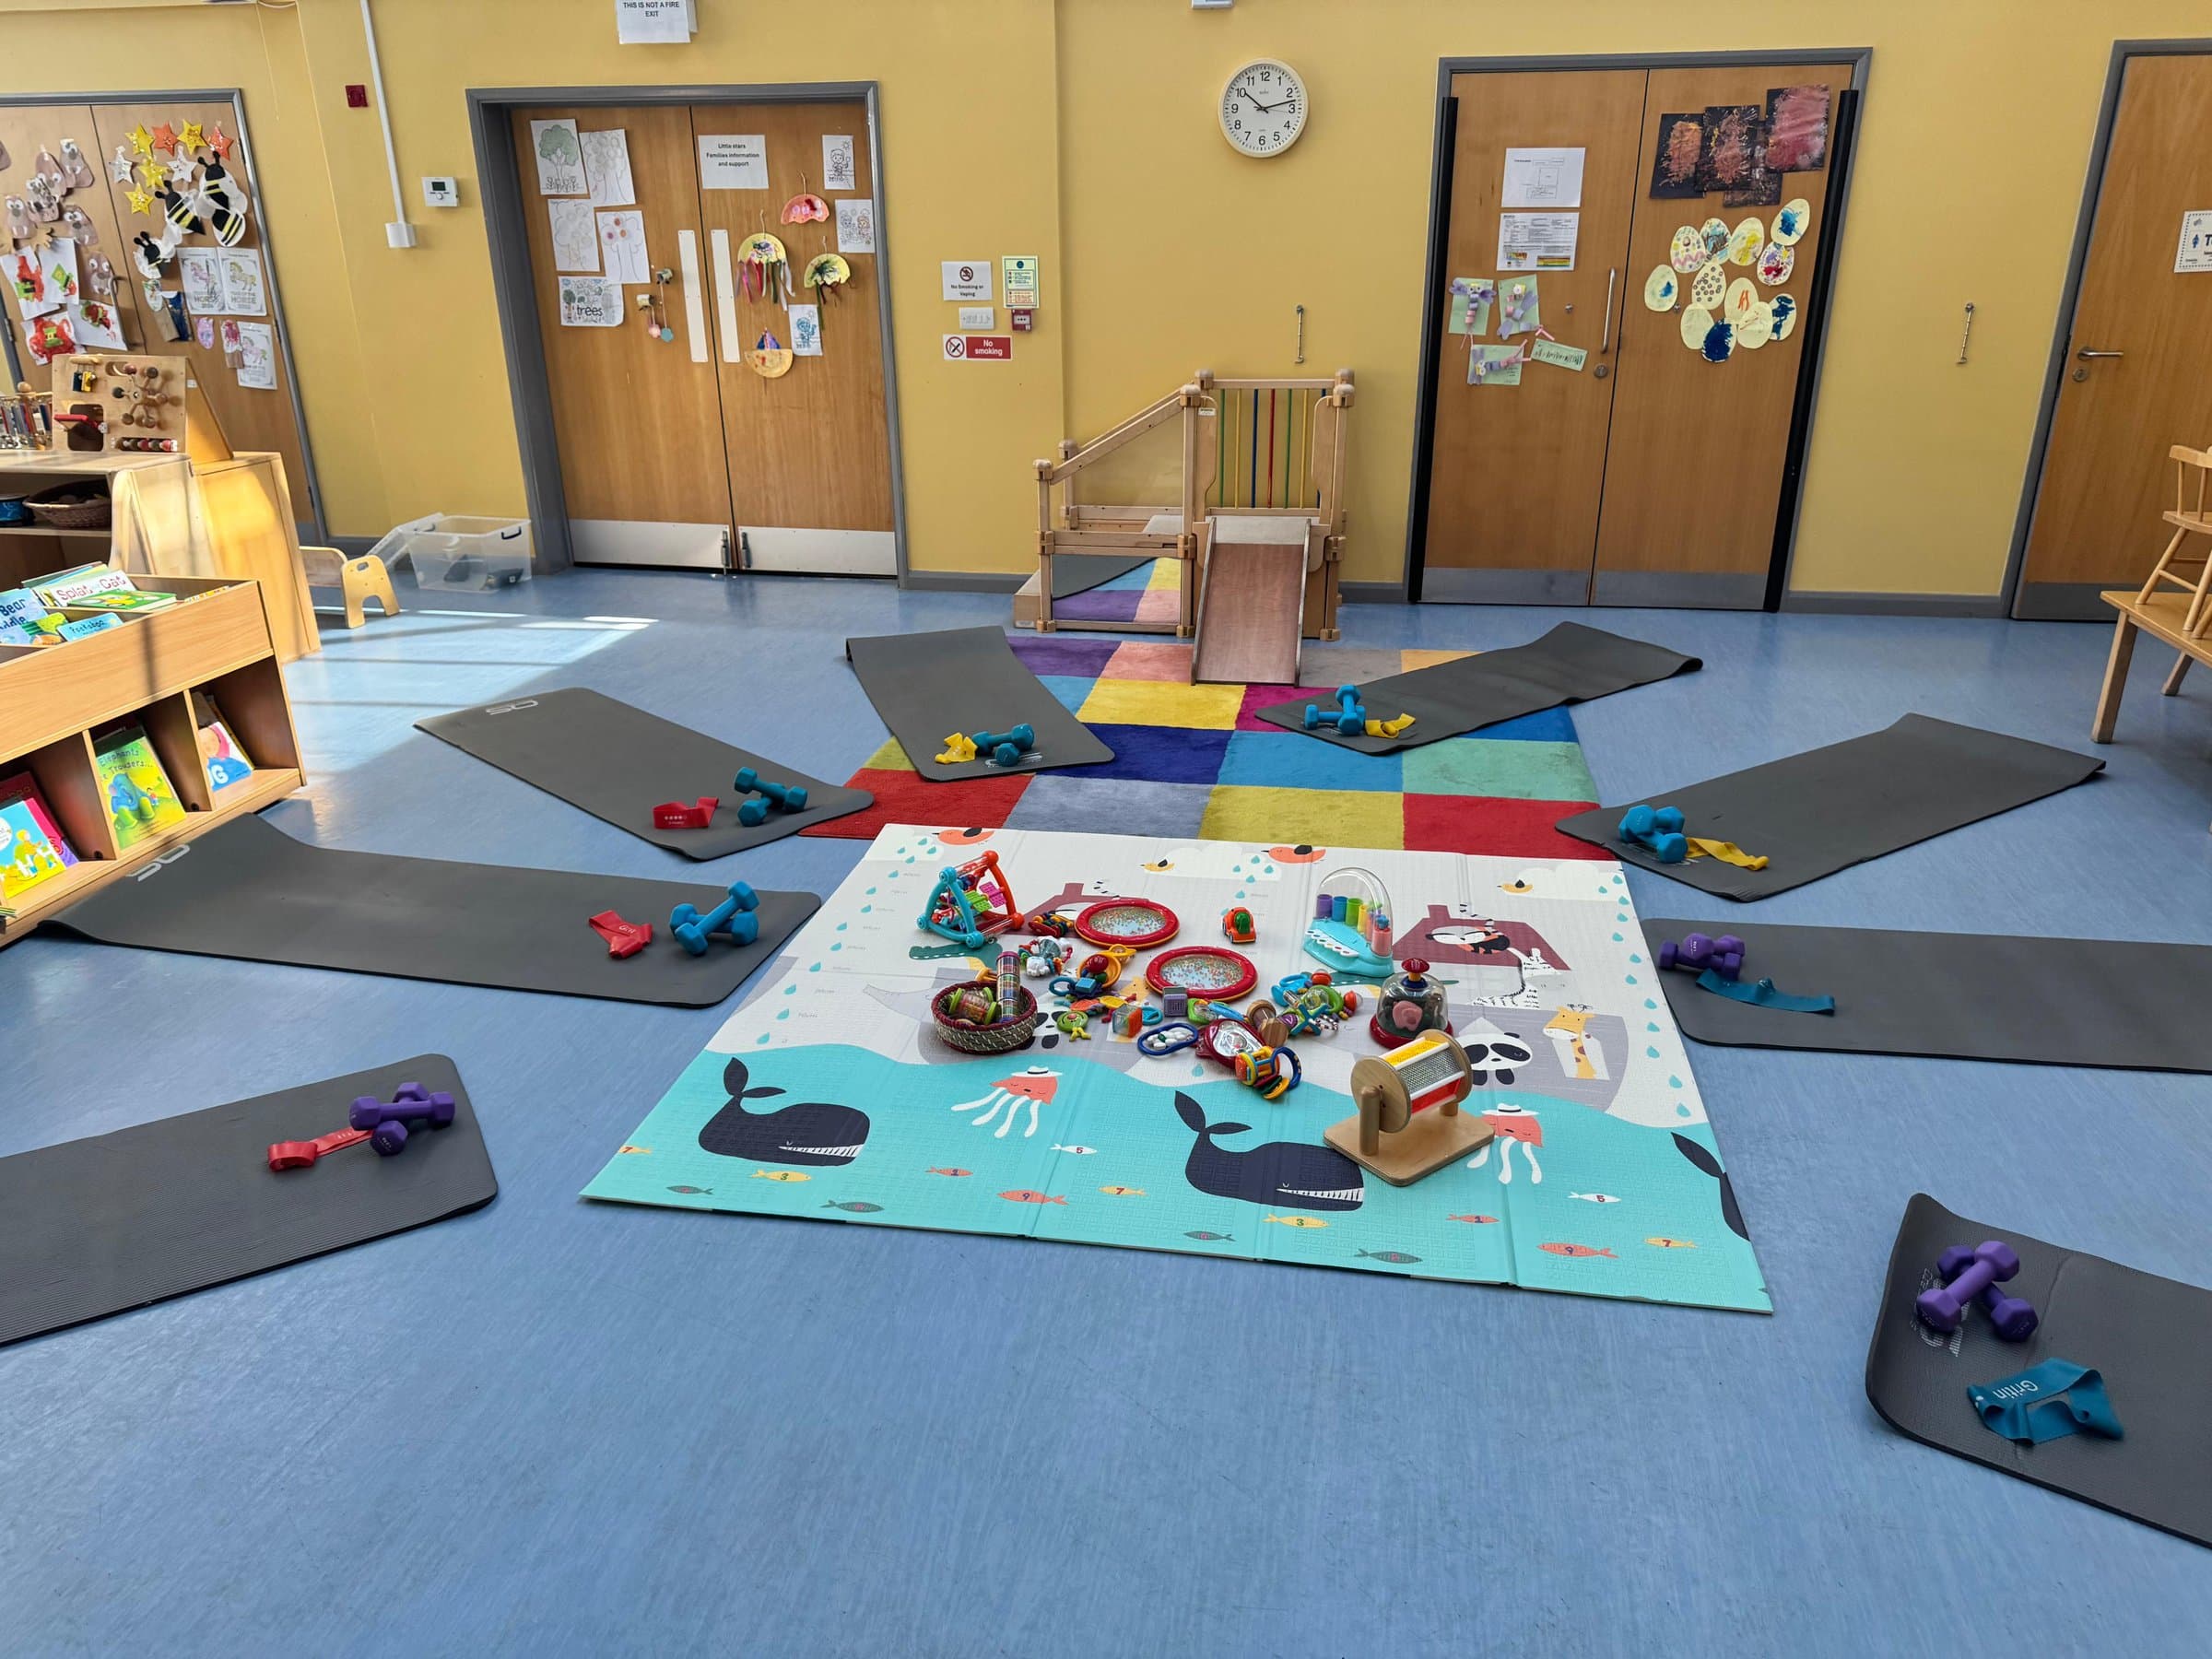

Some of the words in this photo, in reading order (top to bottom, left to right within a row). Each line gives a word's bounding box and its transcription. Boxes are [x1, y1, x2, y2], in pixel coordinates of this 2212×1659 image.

[1247, 76, 1254, 87] 11
[1260, 71, 1270, 82] 12
[1277, 76, 1282, 87] 1
[1235, 88, 1246, 98] 10
[1286, 88, 1293, 98] 2
[1231, 103, 1239, 114] 9
[1288, 103, 1296, 114] 3
[1234, 119, 1241, 130] 8
[1283, 120, 1290, 130] 4
[1244, 131, 1252, 141] 7
[1258, 135, 1266, 146] 6
[1273, 131, 1280, 141] 5
[577, 303, 603, 317] trees
[975, 348, 1003, 357] smoking
[56, 584, 93, 601] Splat
[99, 574, 126, 590] Cat
[780, 1172, 790, 1181] 3
[1115, 1187, 1124, 1195] 7
[1022, 1193, 1030, 1201] 9
[1297, 1218, 1305, 1227] 3
[1662, 1239, 1672, 1248] 7
[1565, 1246, 1574, 1254] 9
[1992, 1380, 2039, 1399] Gritin
